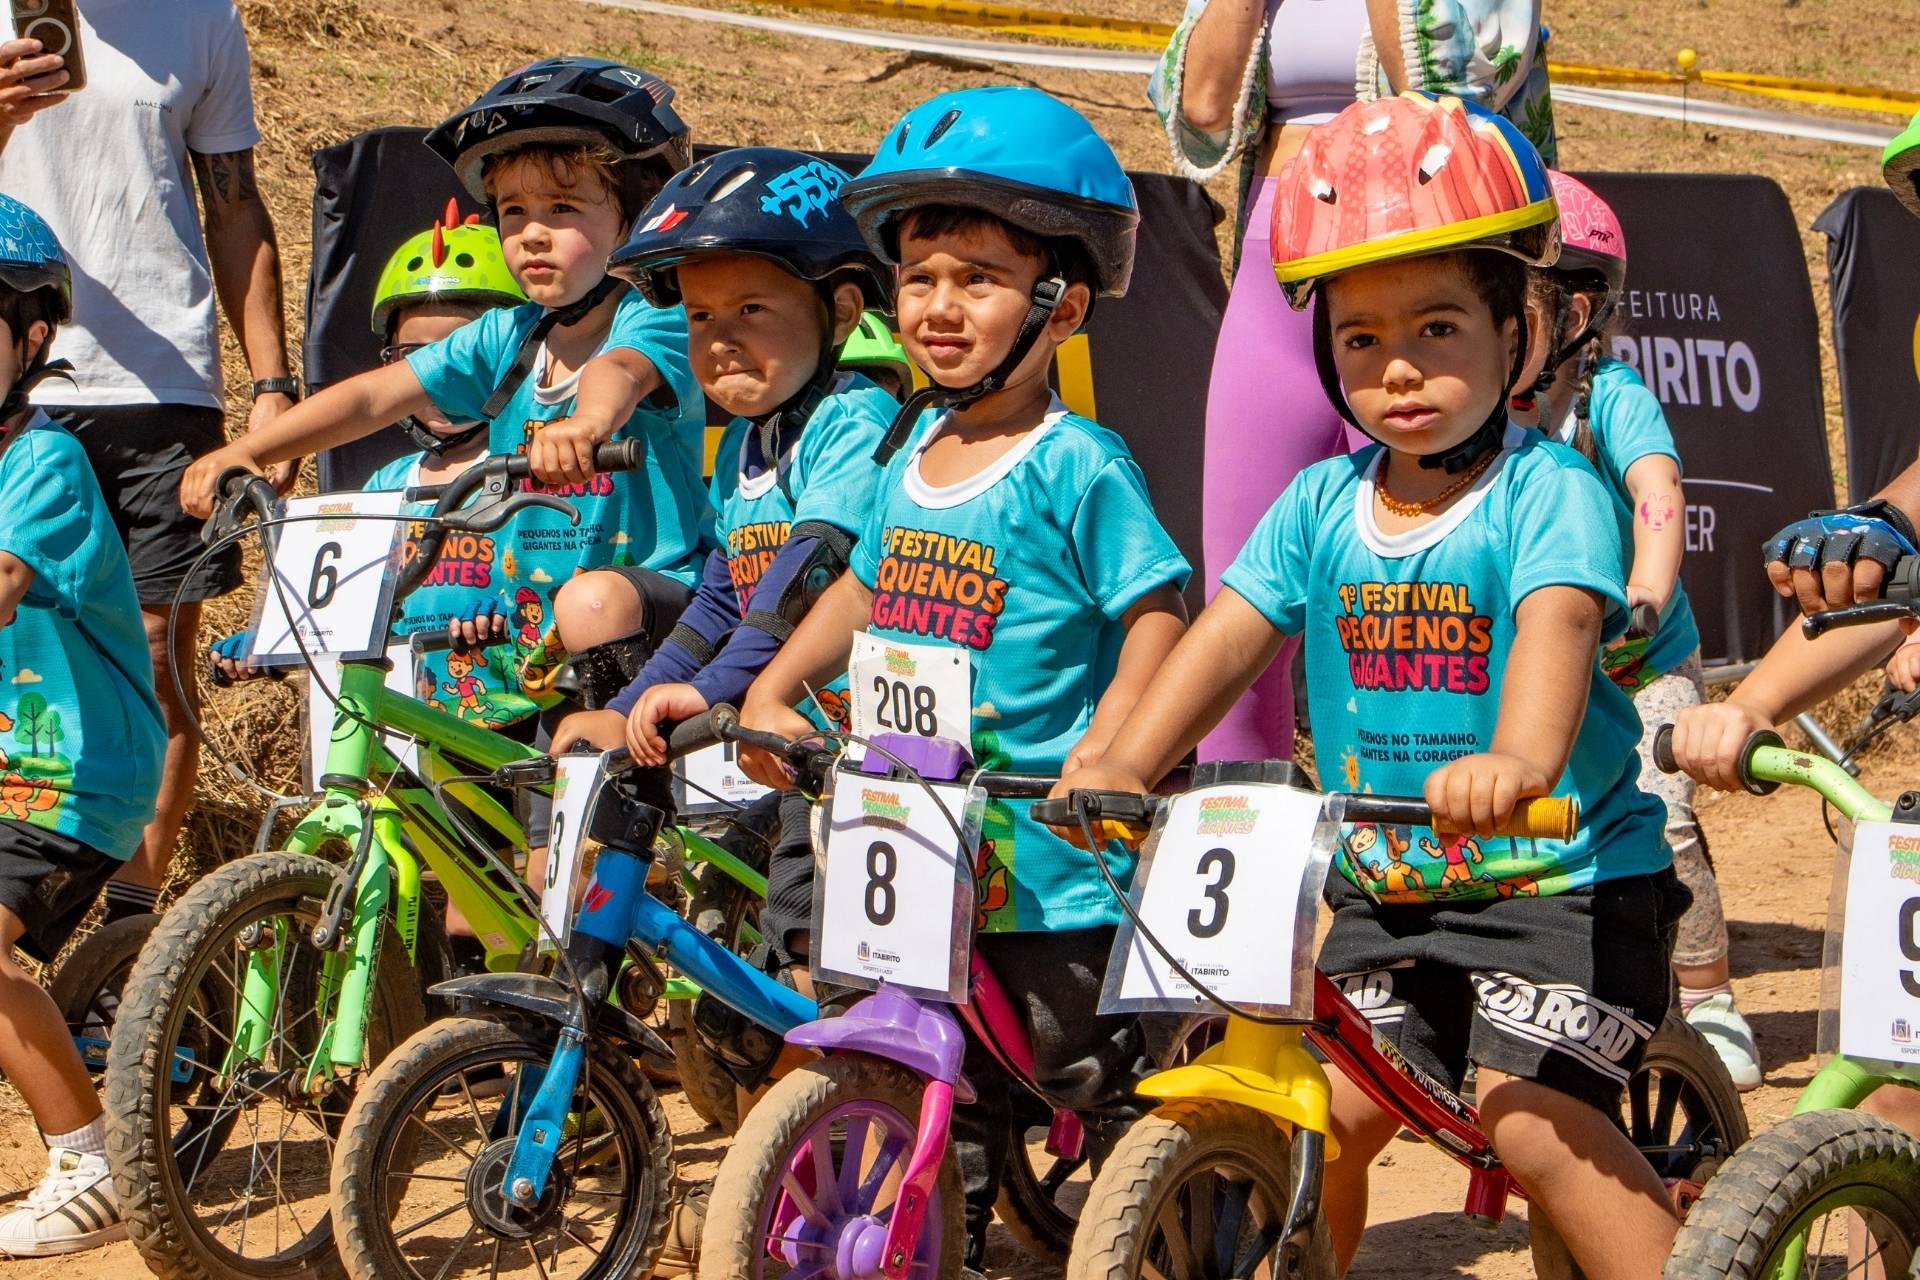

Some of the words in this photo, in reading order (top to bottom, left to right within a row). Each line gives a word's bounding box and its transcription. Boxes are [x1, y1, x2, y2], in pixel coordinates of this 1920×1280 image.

[523, 542, 561, 551] GIGANTES
[564, 542, 577, 551] NA
[563, 529, 577, 538] NO
[890, 527, 996, 575] FESTIVAL
[308, 541, 342, 609] 6
[1361, 583, 1473, 614] FESTIVAL
[1350, 652, 1489, 693] GIGANTES
[874, 676, 938, 737] 208
[1391, 733, 1410, 747] NO
[1413, 733, 1480, 747] TAMANHO,
[1393, 750, 1410, 762] NA
[865, 841, 897, 926] 8
[1187, 848, 1235, 938] 3
[1191, 968, 1229, 976] ITABIRITO
[1534, 991, 1635, 1063] ROAD
